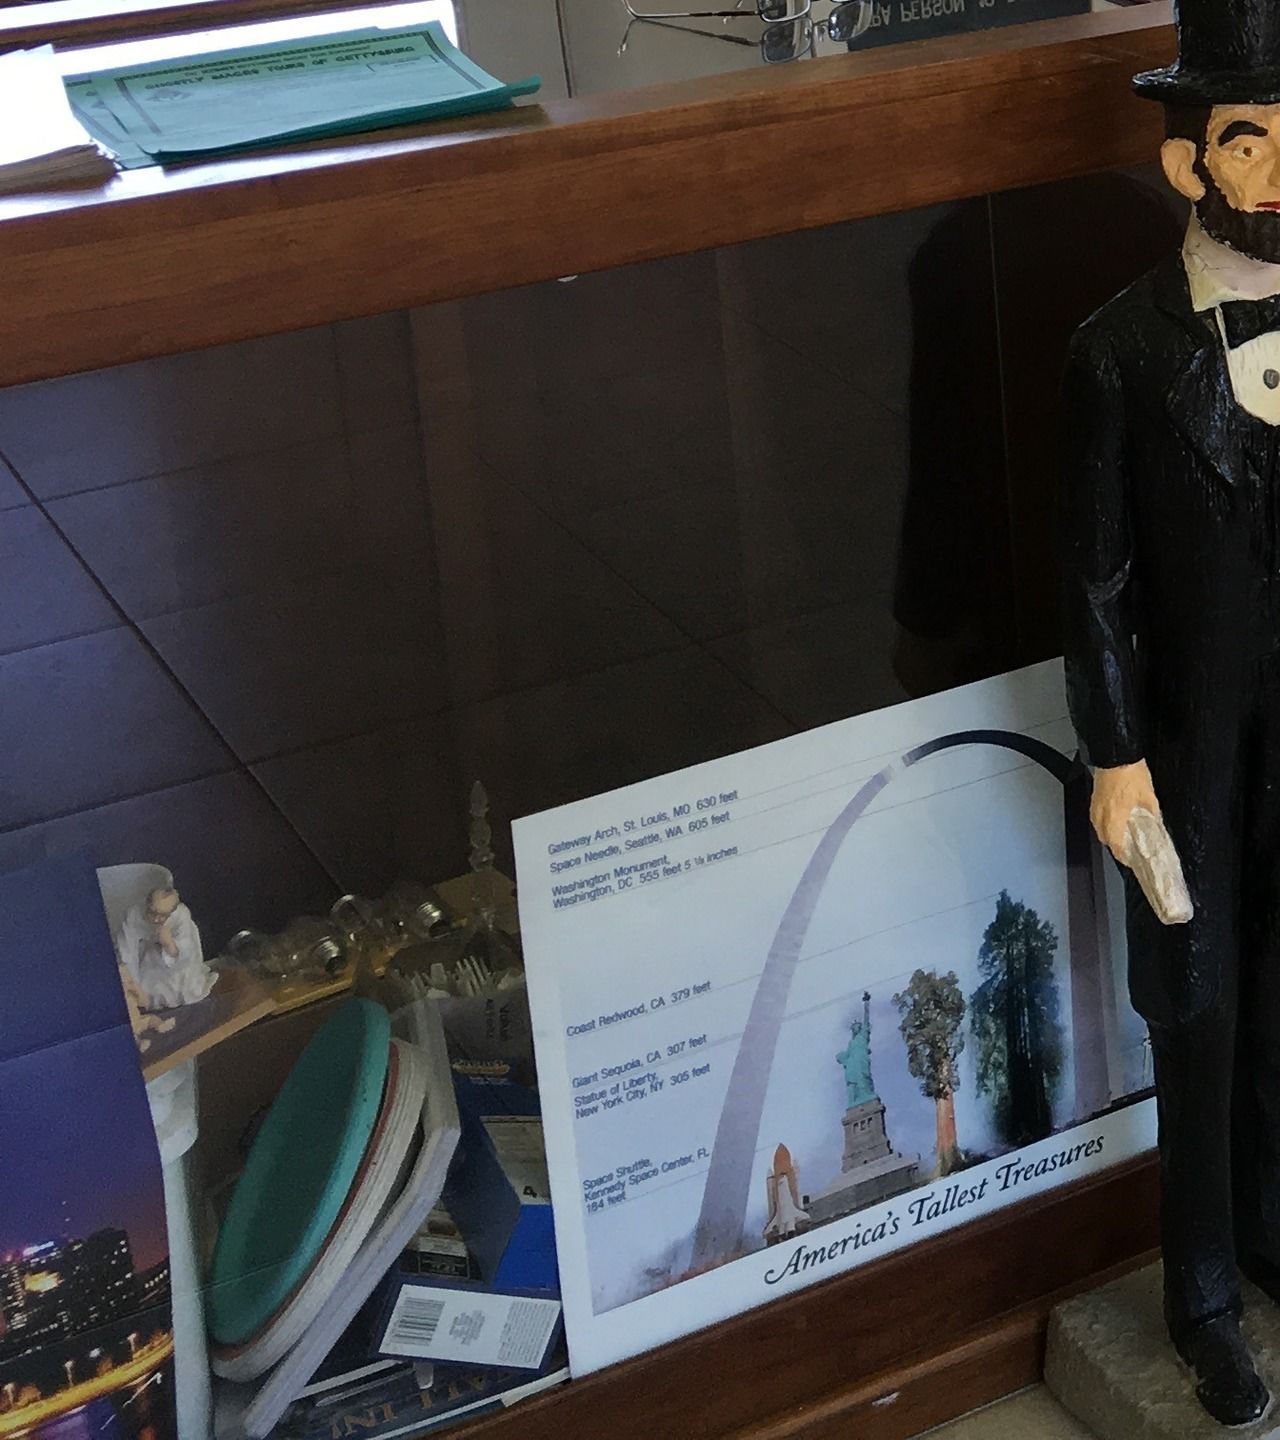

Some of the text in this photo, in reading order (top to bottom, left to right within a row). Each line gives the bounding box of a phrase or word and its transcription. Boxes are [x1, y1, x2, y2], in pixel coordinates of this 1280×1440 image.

[548, 834, 592, 855] Gateway
[594, 825, 621, 841] Arch,
[673, 803, 691, 818] MO
[696, 796, 717, 811] 630
[719, 790, 739, 805] feet
[550, 810, 731, 875] Space Needle, Seattle, WA 605 feet
[551, 854, 671, 898] Washington Monument,
[553, 883, 616, 909] Washington,
[618, 876, 633, 891] DC
[639, 869, 660, 884] 555
[662, 862, 682, 877] feet
[706, 845, 738, 863] inches
[566, 980, 711, 1037] Coast Redwood, CA 379 feet
[572, 1033, 707, 1089] Giant Sequoia, CA 307 feet
[574, 1088, 607, 1107] Statue
[609, 1082, 620, 1096] of
[575, 1063, 711, 1120] New York City, NY 305 feet
[583, 1171, 614, 1191] Space
[584, 1180, 626, 1203] Kennedy
[628, 1166, 659, 1186] Space
[697, 1146, 710, 1160] FL
[606, 1190, 626, 1206] feet
[764, 1134, 1105, 1285] America's Tallest Treasures
